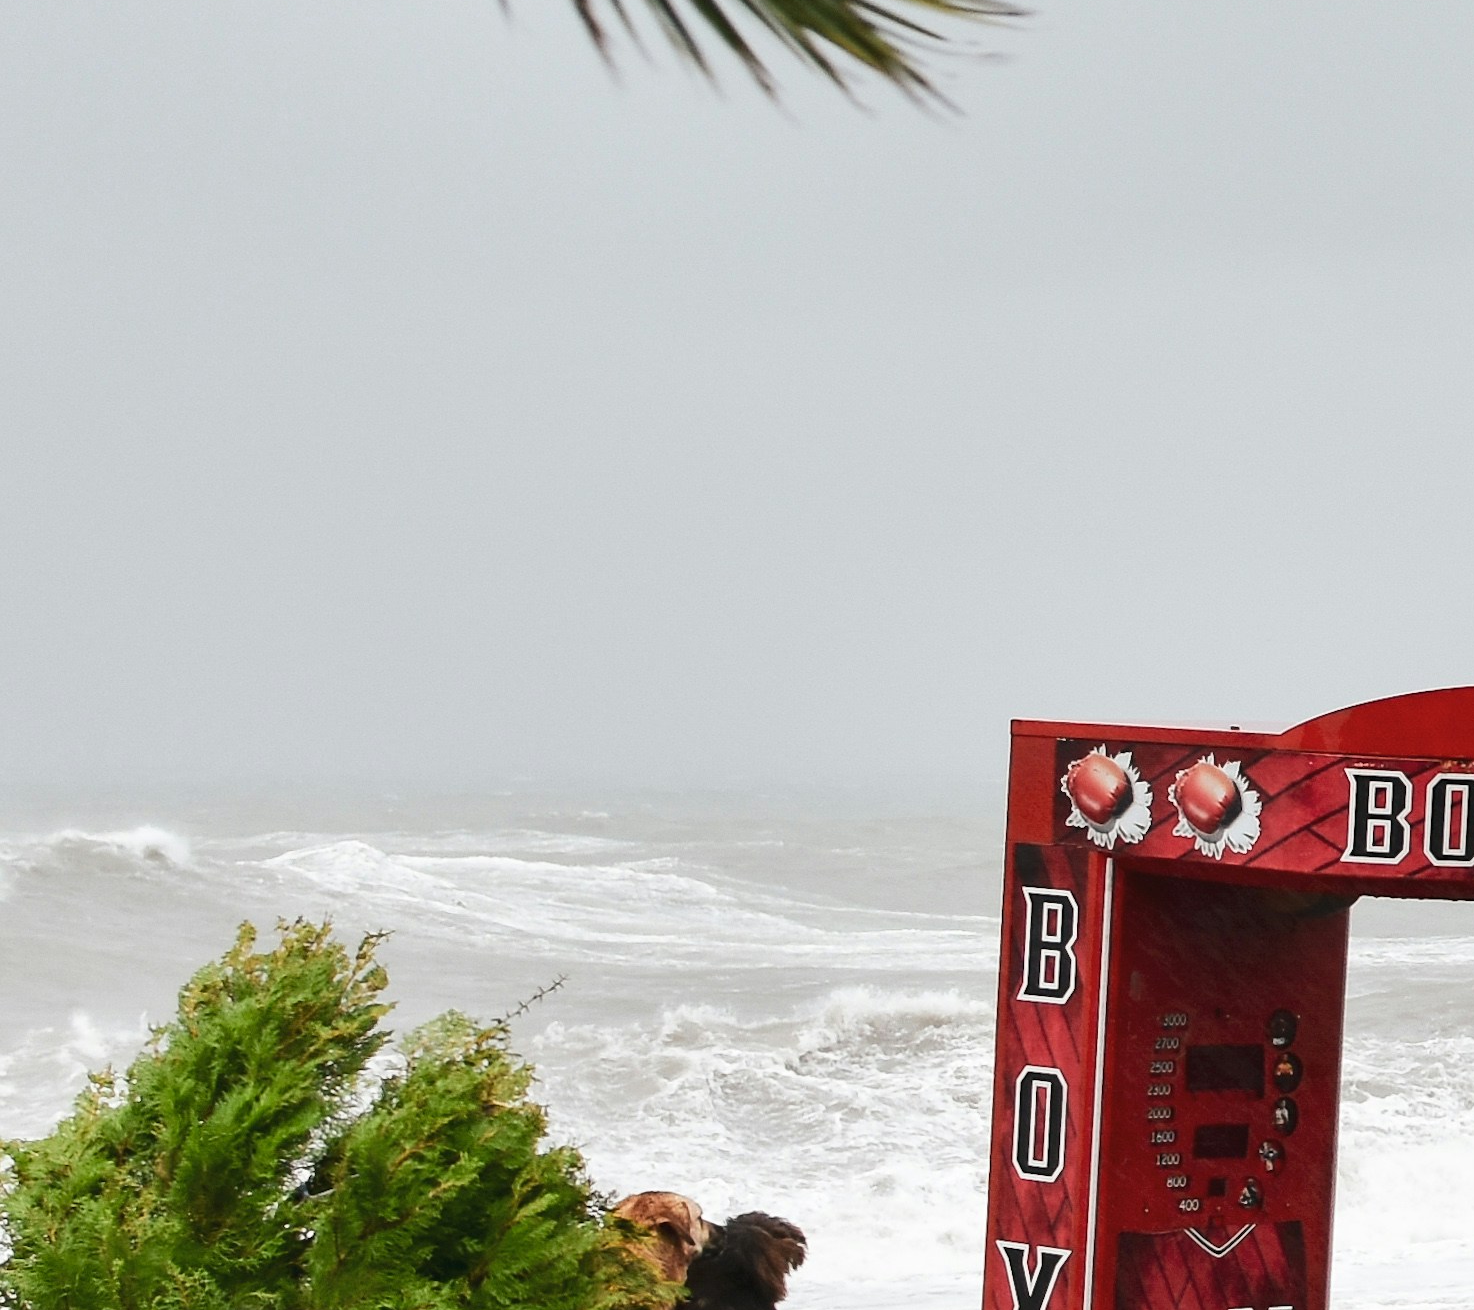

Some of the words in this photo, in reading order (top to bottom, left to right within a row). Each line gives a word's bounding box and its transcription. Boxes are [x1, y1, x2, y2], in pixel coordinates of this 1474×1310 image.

[1154, 1036, 1180, 1050] 2700
[1149, 1060, 1174, 1074] 2500
[1146, 1083, 1171, 1097] 2300
[1147, 1106, 1172, 1120] 2000
[1150, 1130, 1175, 1144] 1600
[1155, 1153, 1180, 1166] 1200
[1165, 1175, 1187, 1189] 800
[1178, 1198, 1200, 1212] 400
